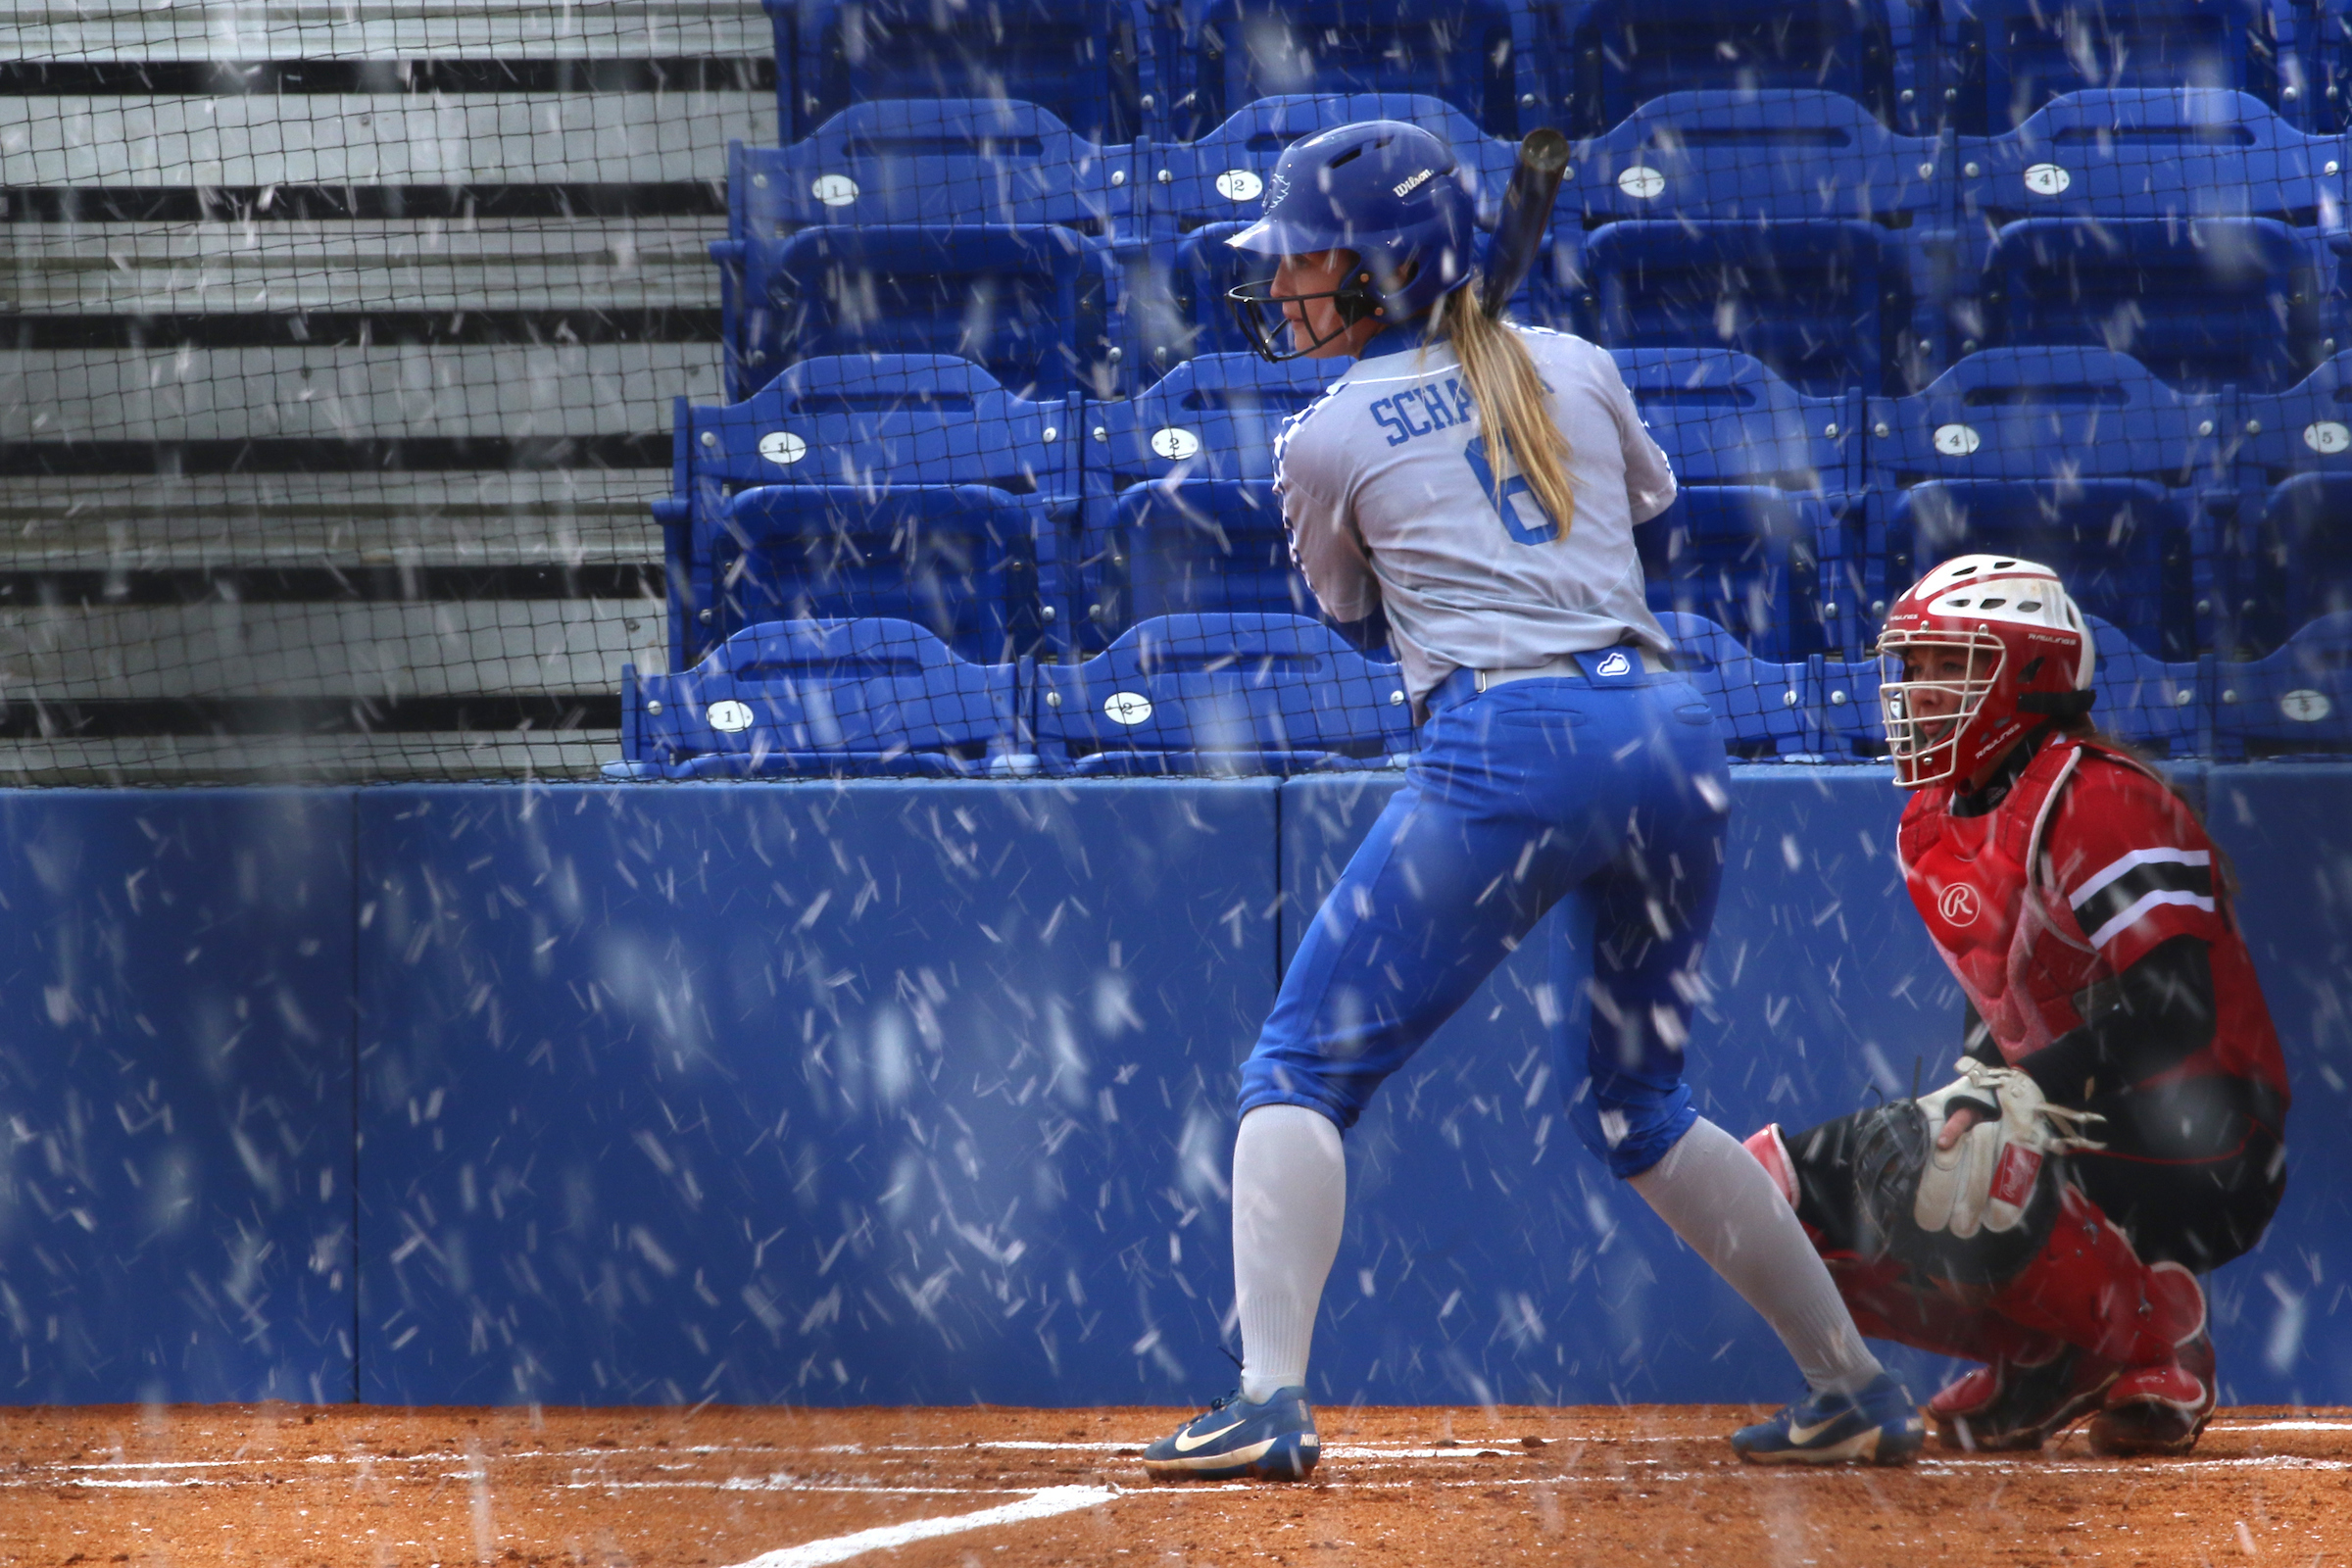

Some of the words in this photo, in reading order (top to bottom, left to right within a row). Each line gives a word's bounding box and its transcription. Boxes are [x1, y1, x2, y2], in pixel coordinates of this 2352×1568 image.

[1235, 179, 1245, 192] 2
[1393, 170, 1432, 198] Wilson
[1637, 176, 1646, 188] 3
[2040, 174, 2050, 186] 4
[833, 185, 839, 197] 1
[1169, 438, 1180, 450] 2
[1950, 435, 1960, 447] 4
[2322, 432, 2332, 444] 5
[1464, 427, 1560, 546] 6
[2028, 633, 2077, 647] RAWLINGS
[1122, 703, 1133, 714] 2
[725, 710, 733, 723] 1
[1975, 722, 2021, 760] RAWLINGS
[1943, 886, 1973, 918] R
